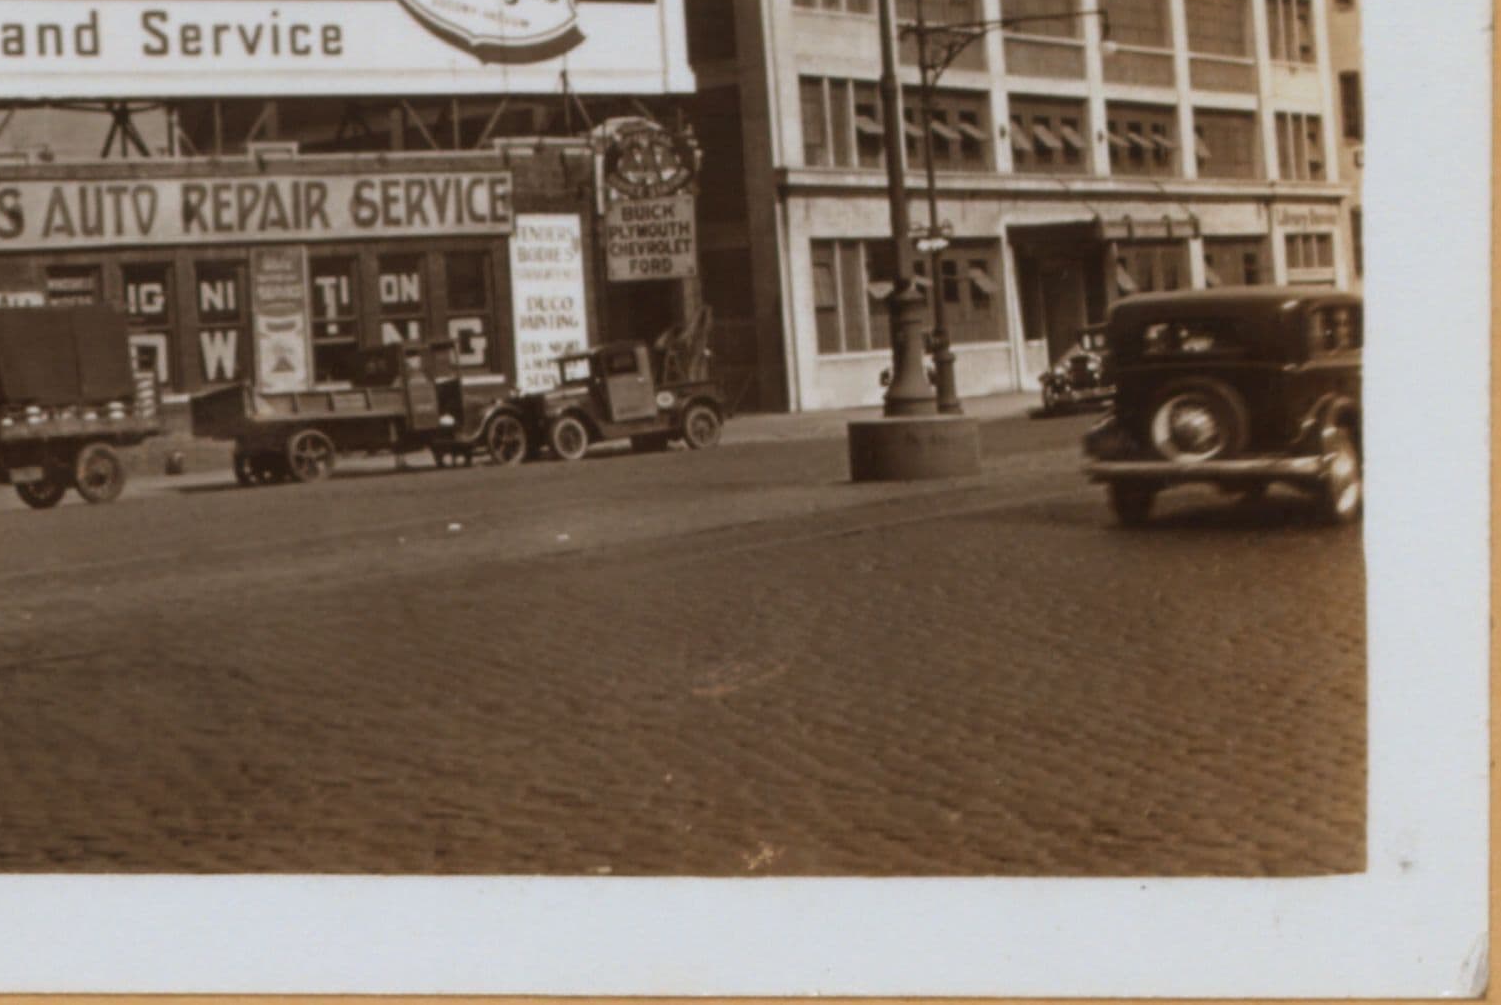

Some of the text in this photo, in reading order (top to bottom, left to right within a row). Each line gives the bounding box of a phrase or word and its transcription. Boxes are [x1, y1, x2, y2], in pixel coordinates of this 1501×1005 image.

[0, 11, 100, 57] and
[140, 10, 344, 57] Service
[41, 182, 159, 241] AUTO
[181, 179, 332, 234] REPAIR
[349, 177, 509, 229] SERVICE
[620, 204, 676, 223] BUICK
[607, 221, 693, 241] PLYMOUTH
[608, 238, 695, 257] CHEVROLET
[628, 256, 674, 275] FORD
